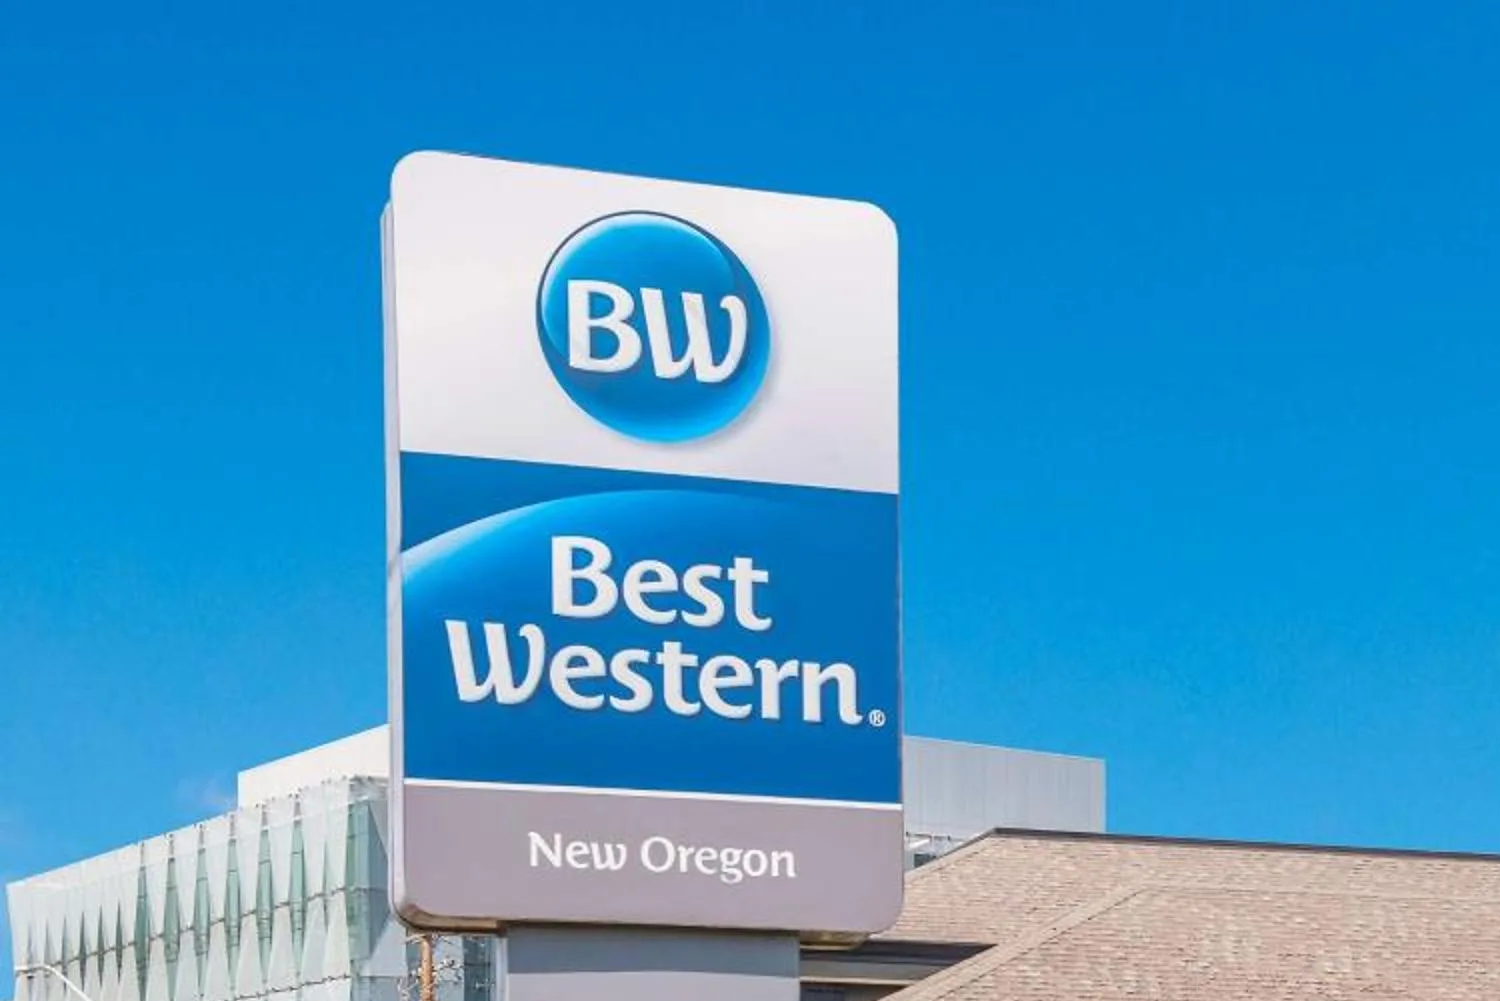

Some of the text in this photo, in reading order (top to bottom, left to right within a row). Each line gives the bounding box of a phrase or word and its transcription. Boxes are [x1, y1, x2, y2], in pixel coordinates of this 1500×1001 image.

[568, 280, 747, 383] BW
[551, 536, 772, 630] Best
[527, 831, 796, 883] New Oregon
